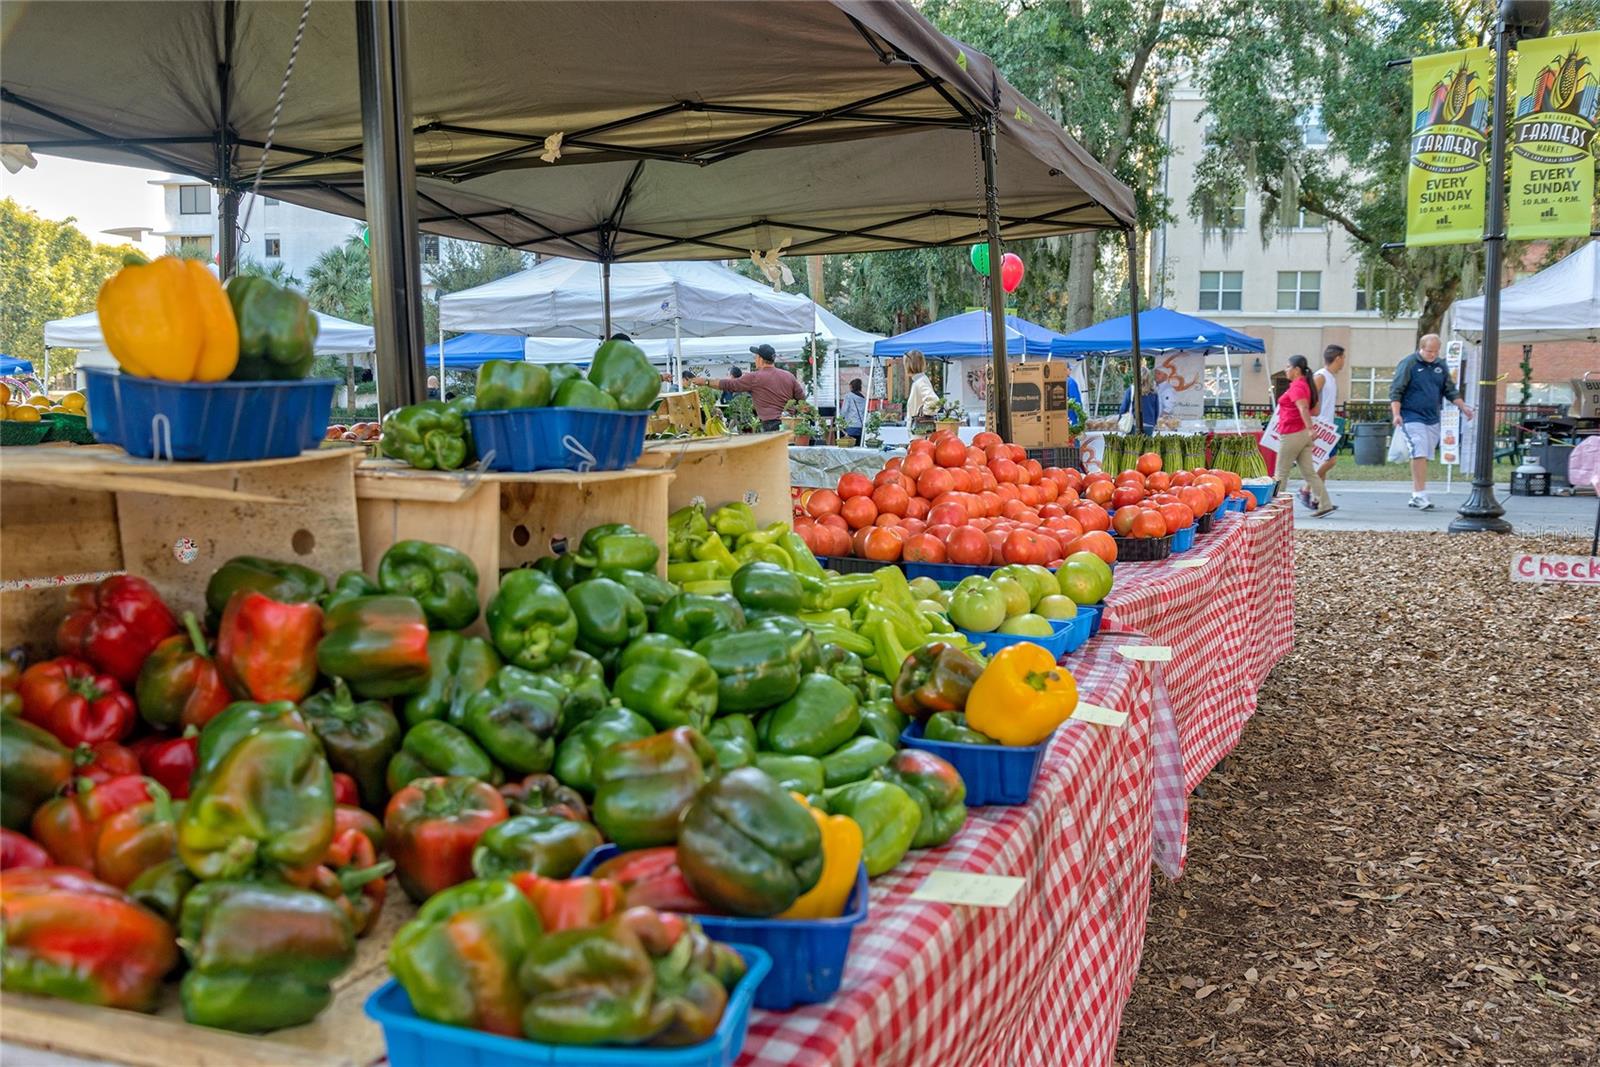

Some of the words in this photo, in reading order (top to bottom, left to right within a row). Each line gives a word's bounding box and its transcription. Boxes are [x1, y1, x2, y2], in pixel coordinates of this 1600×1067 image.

[1520, 123, 1587, 147] FARMERS
[1416, 135, 1479, 157] FARMERS
[1536, 144, 1564, 153] MARKET
[1432, 155, 1457, 163] MARKET
[1530, 167, 1576, 181] EVERY
[1426, 176, 1468, 190] EVERY
[1523, 180, 1582, 195] SUNDAY
[1420, 189, 1473, 204] SUNDAY
[1533, 197, 1550, 205] A.M.
[1565, 195, 1581, 203] P.M.
[1517, 555, 1600, 578] Check
